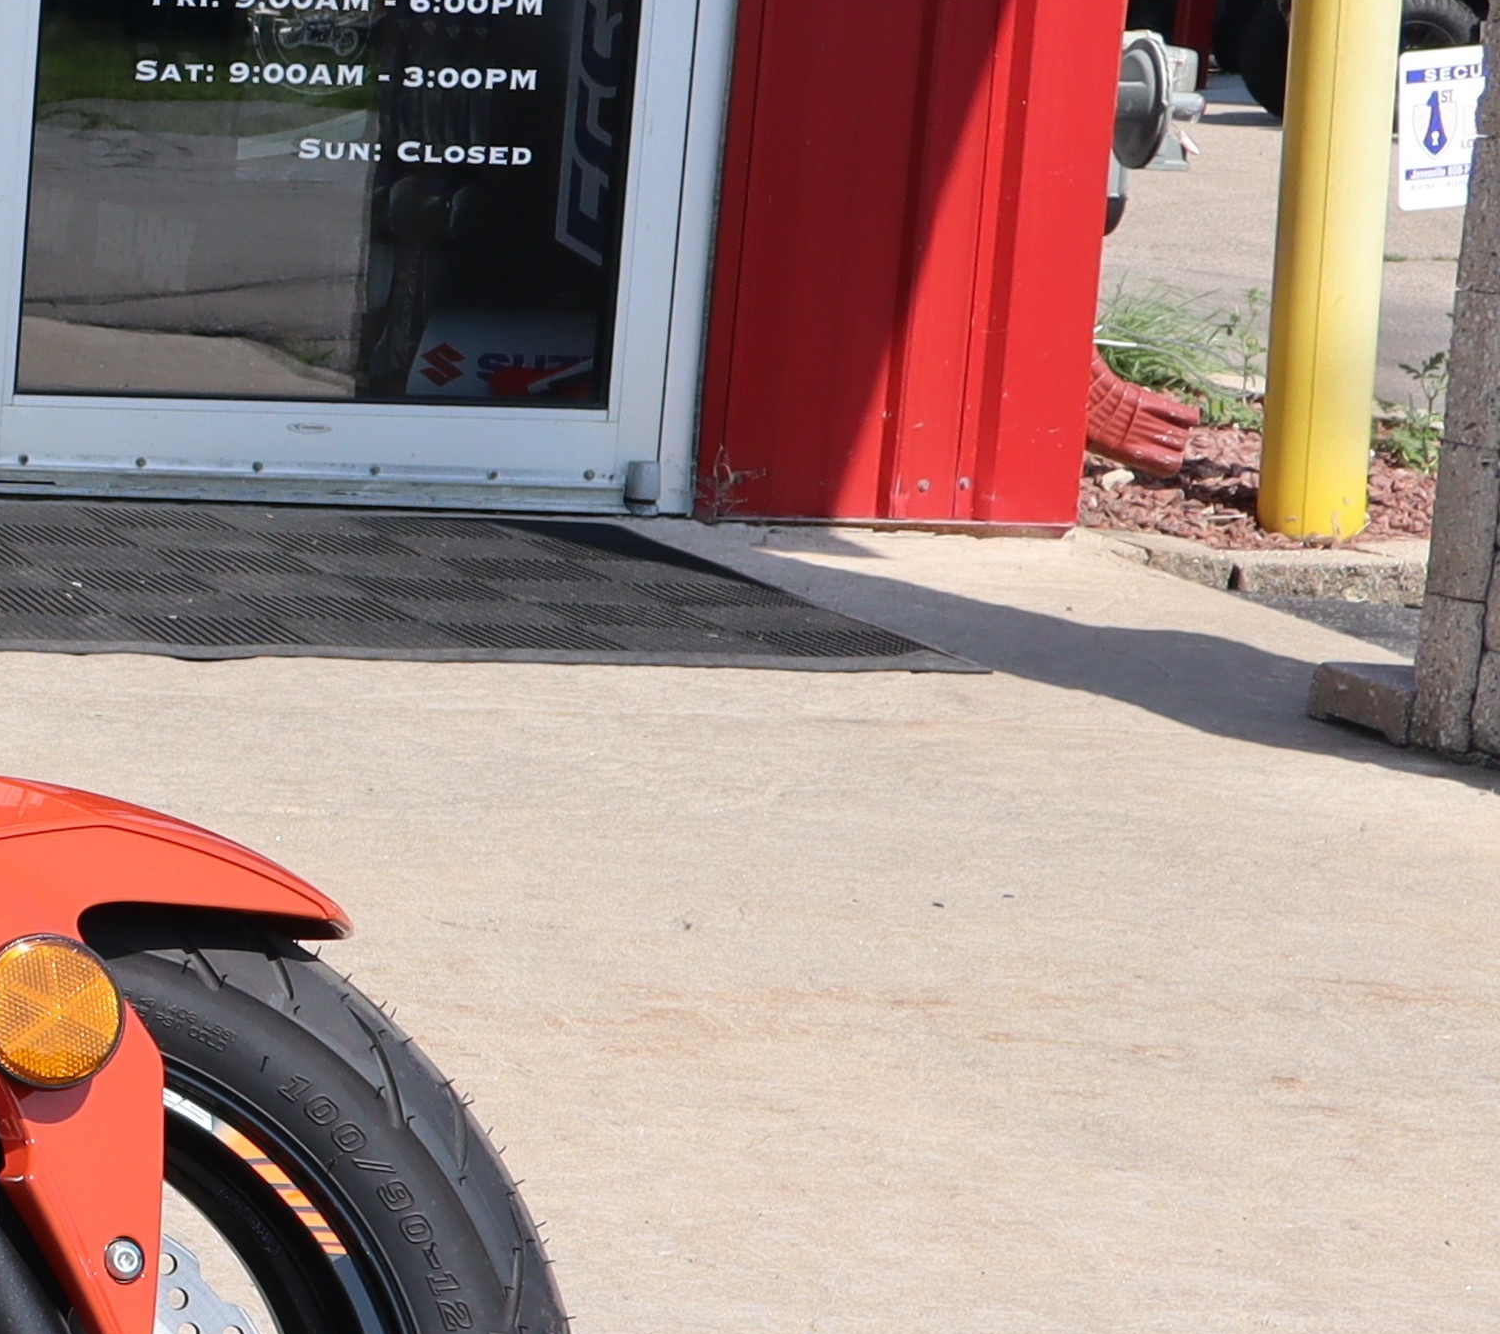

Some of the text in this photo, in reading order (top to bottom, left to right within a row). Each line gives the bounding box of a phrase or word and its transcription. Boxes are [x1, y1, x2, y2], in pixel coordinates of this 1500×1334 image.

[134, 61, 215, 85] SAT:
[228, 62, 365, 88] 9:00AM
[402, 67, 538, 92] 3:00PM
[298, 139, 532, 168] SUN: CLOSED
[277, 1074, 473, 1333] 100/90-12
